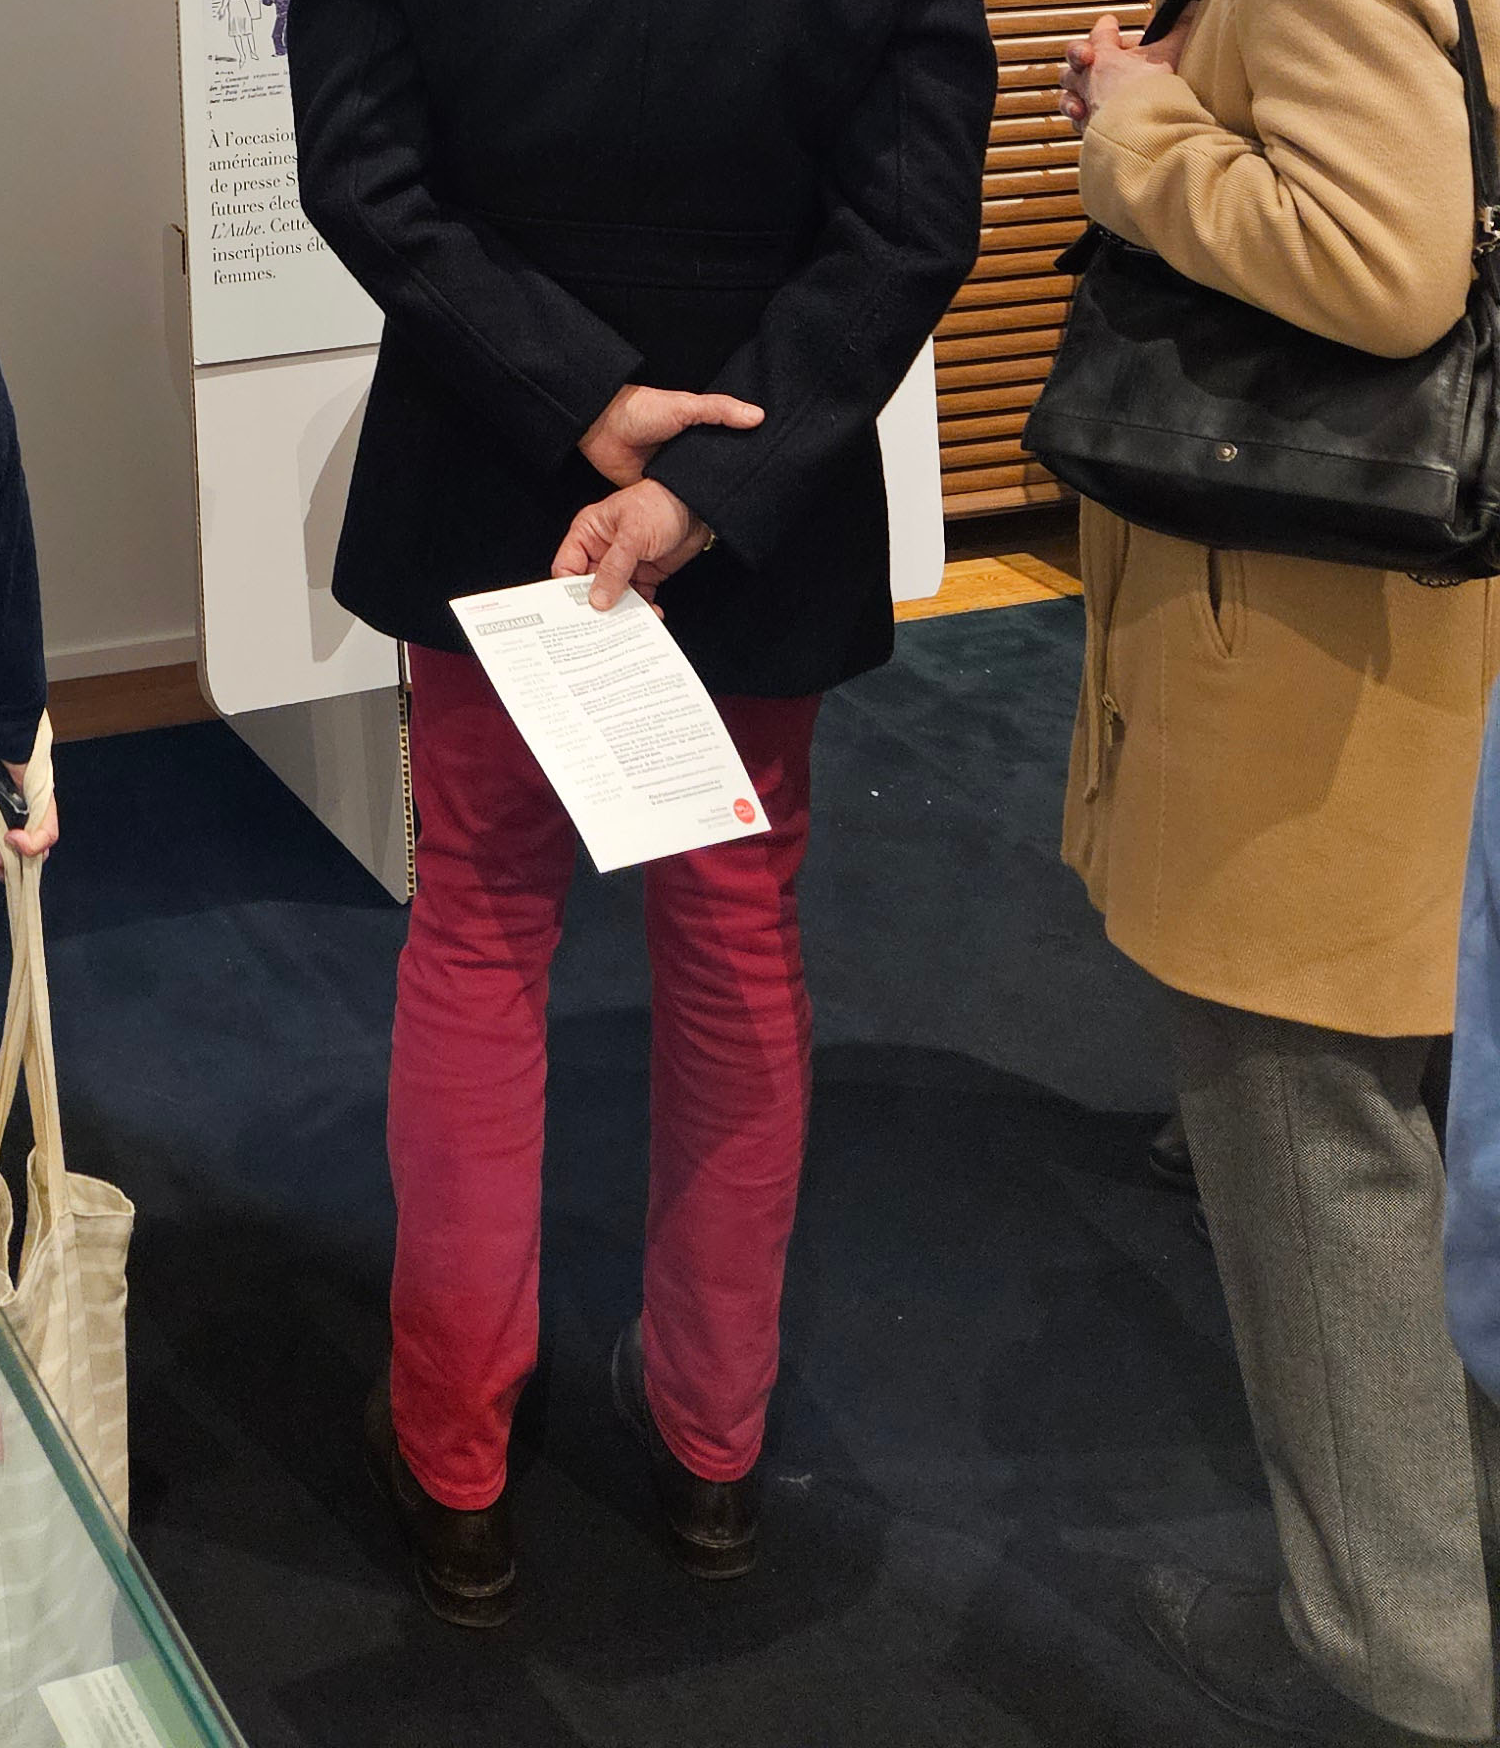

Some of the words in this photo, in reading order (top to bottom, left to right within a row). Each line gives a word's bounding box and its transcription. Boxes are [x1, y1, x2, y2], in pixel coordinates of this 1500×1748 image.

[270, 217, 309, 232] Cette
[212, 241, 302, 263] inscriptions
[214, 268, 276, 286] femmes.
[477, 613, 543, 635] PROGRAMME
